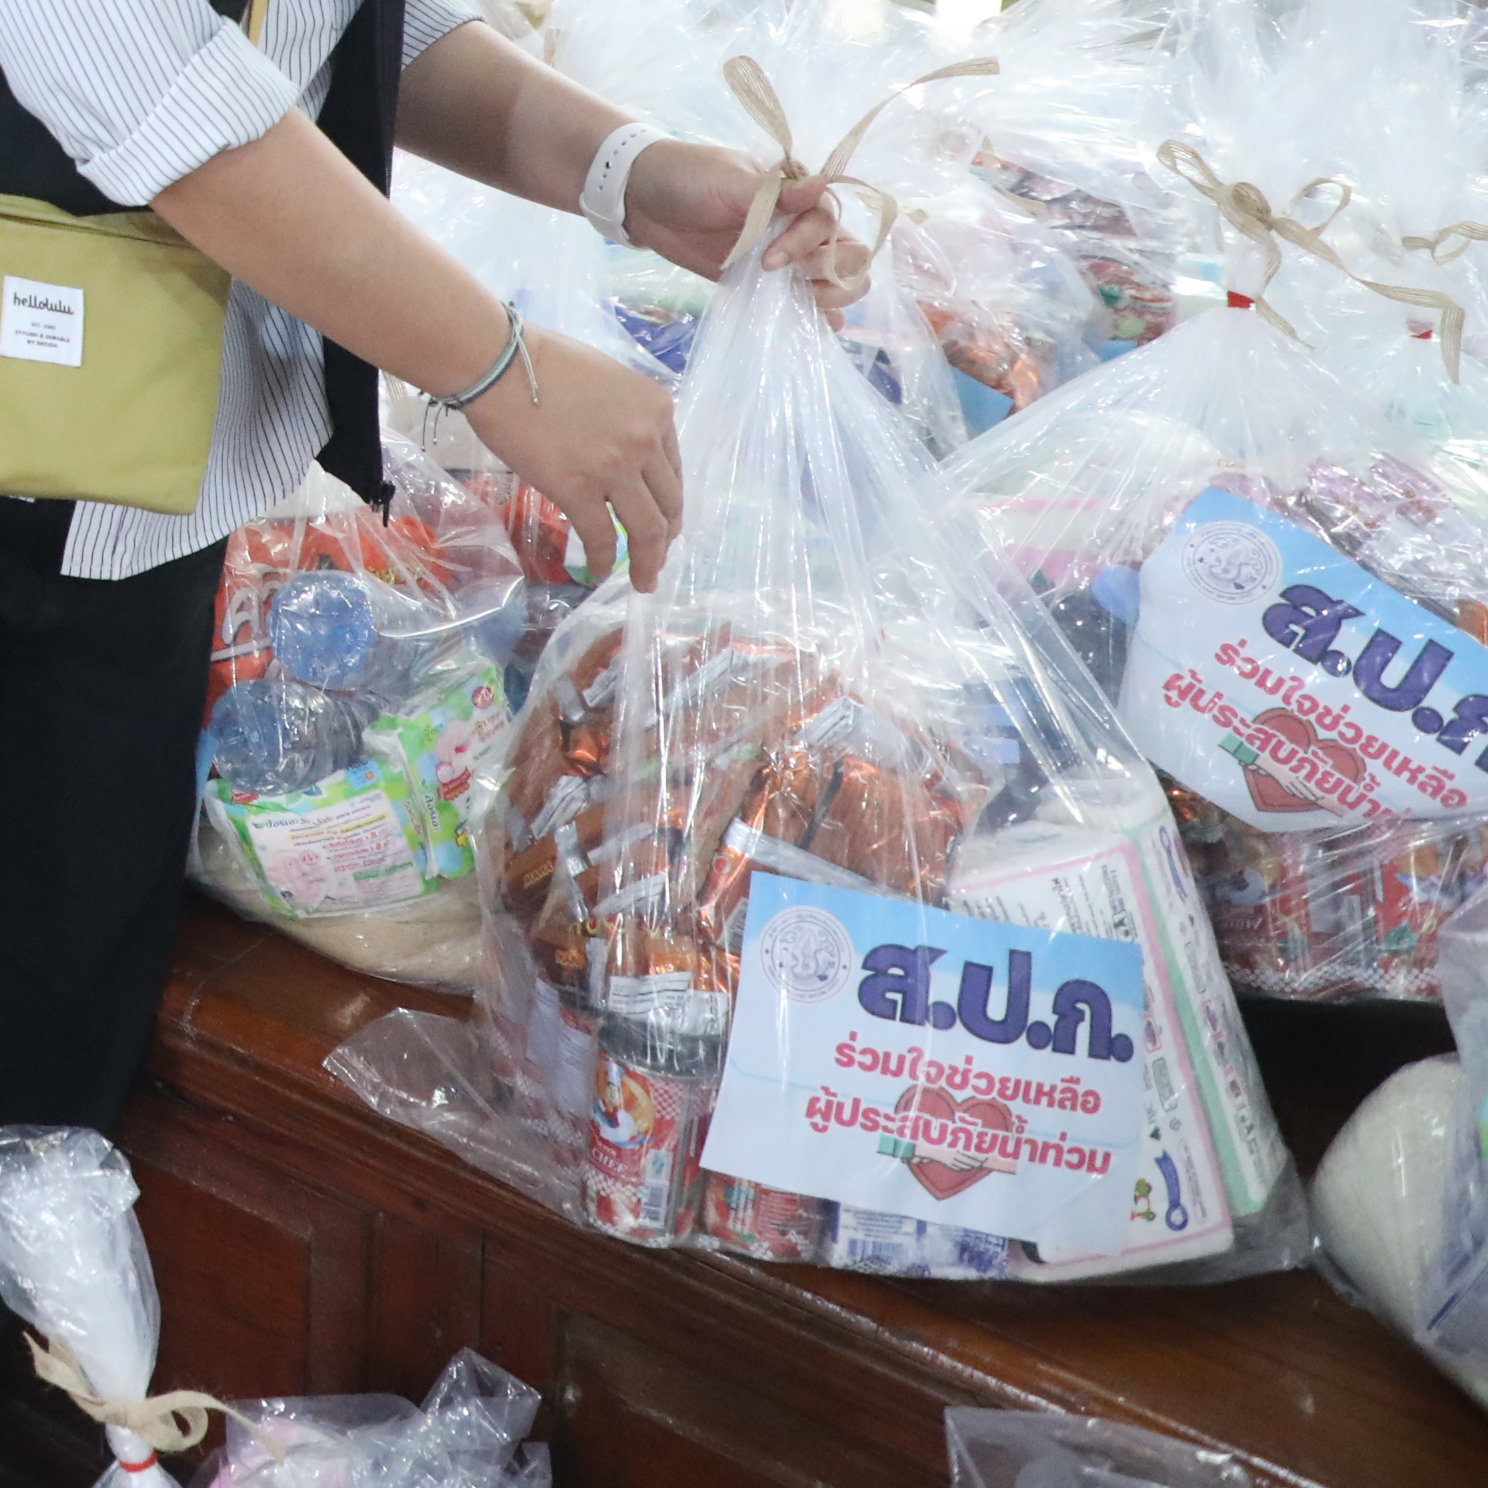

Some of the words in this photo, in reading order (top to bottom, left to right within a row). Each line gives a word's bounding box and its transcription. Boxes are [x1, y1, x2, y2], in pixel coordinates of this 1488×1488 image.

[13, 291, 74, 315] hellolulu
[1214, 638, 1469, 810] ร่วมใจช่วยเหลือ
[857, 942, 1135, 1063] ส.ป.ก.
[834, 1030, 1102, 1116] ร่วมใจช่วยเหลือ
[804, 1085, 1112, 1175] ผู้ประสบภัยน้ำท่วม
